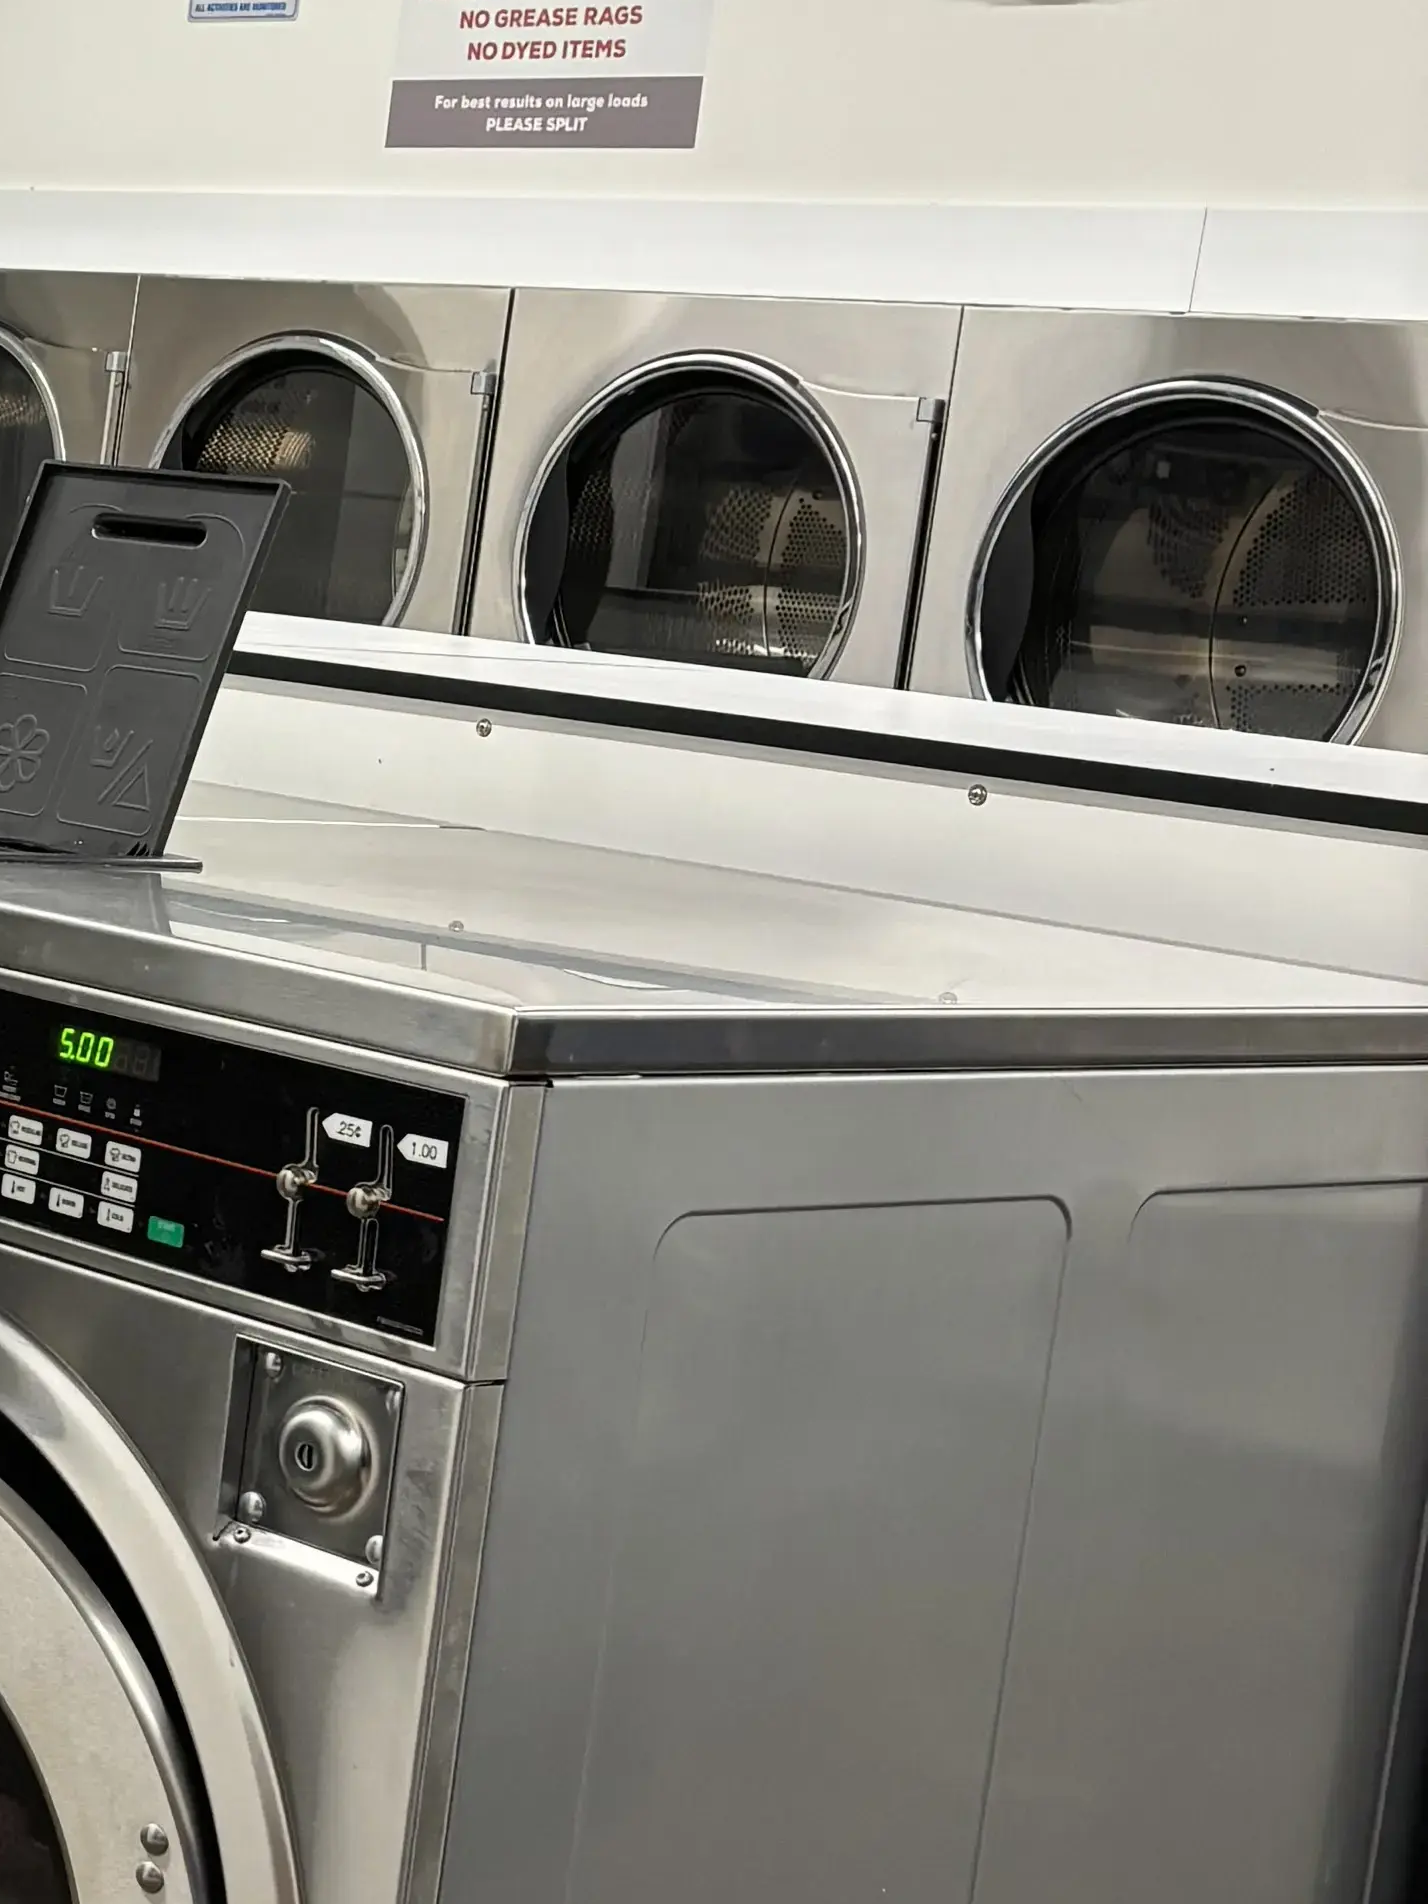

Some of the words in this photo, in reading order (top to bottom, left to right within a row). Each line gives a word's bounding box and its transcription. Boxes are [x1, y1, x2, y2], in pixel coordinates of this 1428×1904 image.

[459, 10, 490, 29] NO
[494, 7, 578, 28] GREASE
[583, 5, 643, 27] RAGS
[467, 42, 498, 61] NO
[500, 41, 557, 60] DYED
[562, 39, 627, 59] ITEMS
[434, 95, 457, 109] For
[461, 95, 491, 109] best
[494, 94, 542, 109] results
[545, 98, 563, 109] on
[567, 94, 605, 112] large
[607, 93, 648, 108] loads
[486, 116, 543, 132] PLEASE
[545, 115, 588, 132] SPLIT
[59, 1027, 114, 1068] 5.00
[412, 1141, 438, 1161] 1.00
